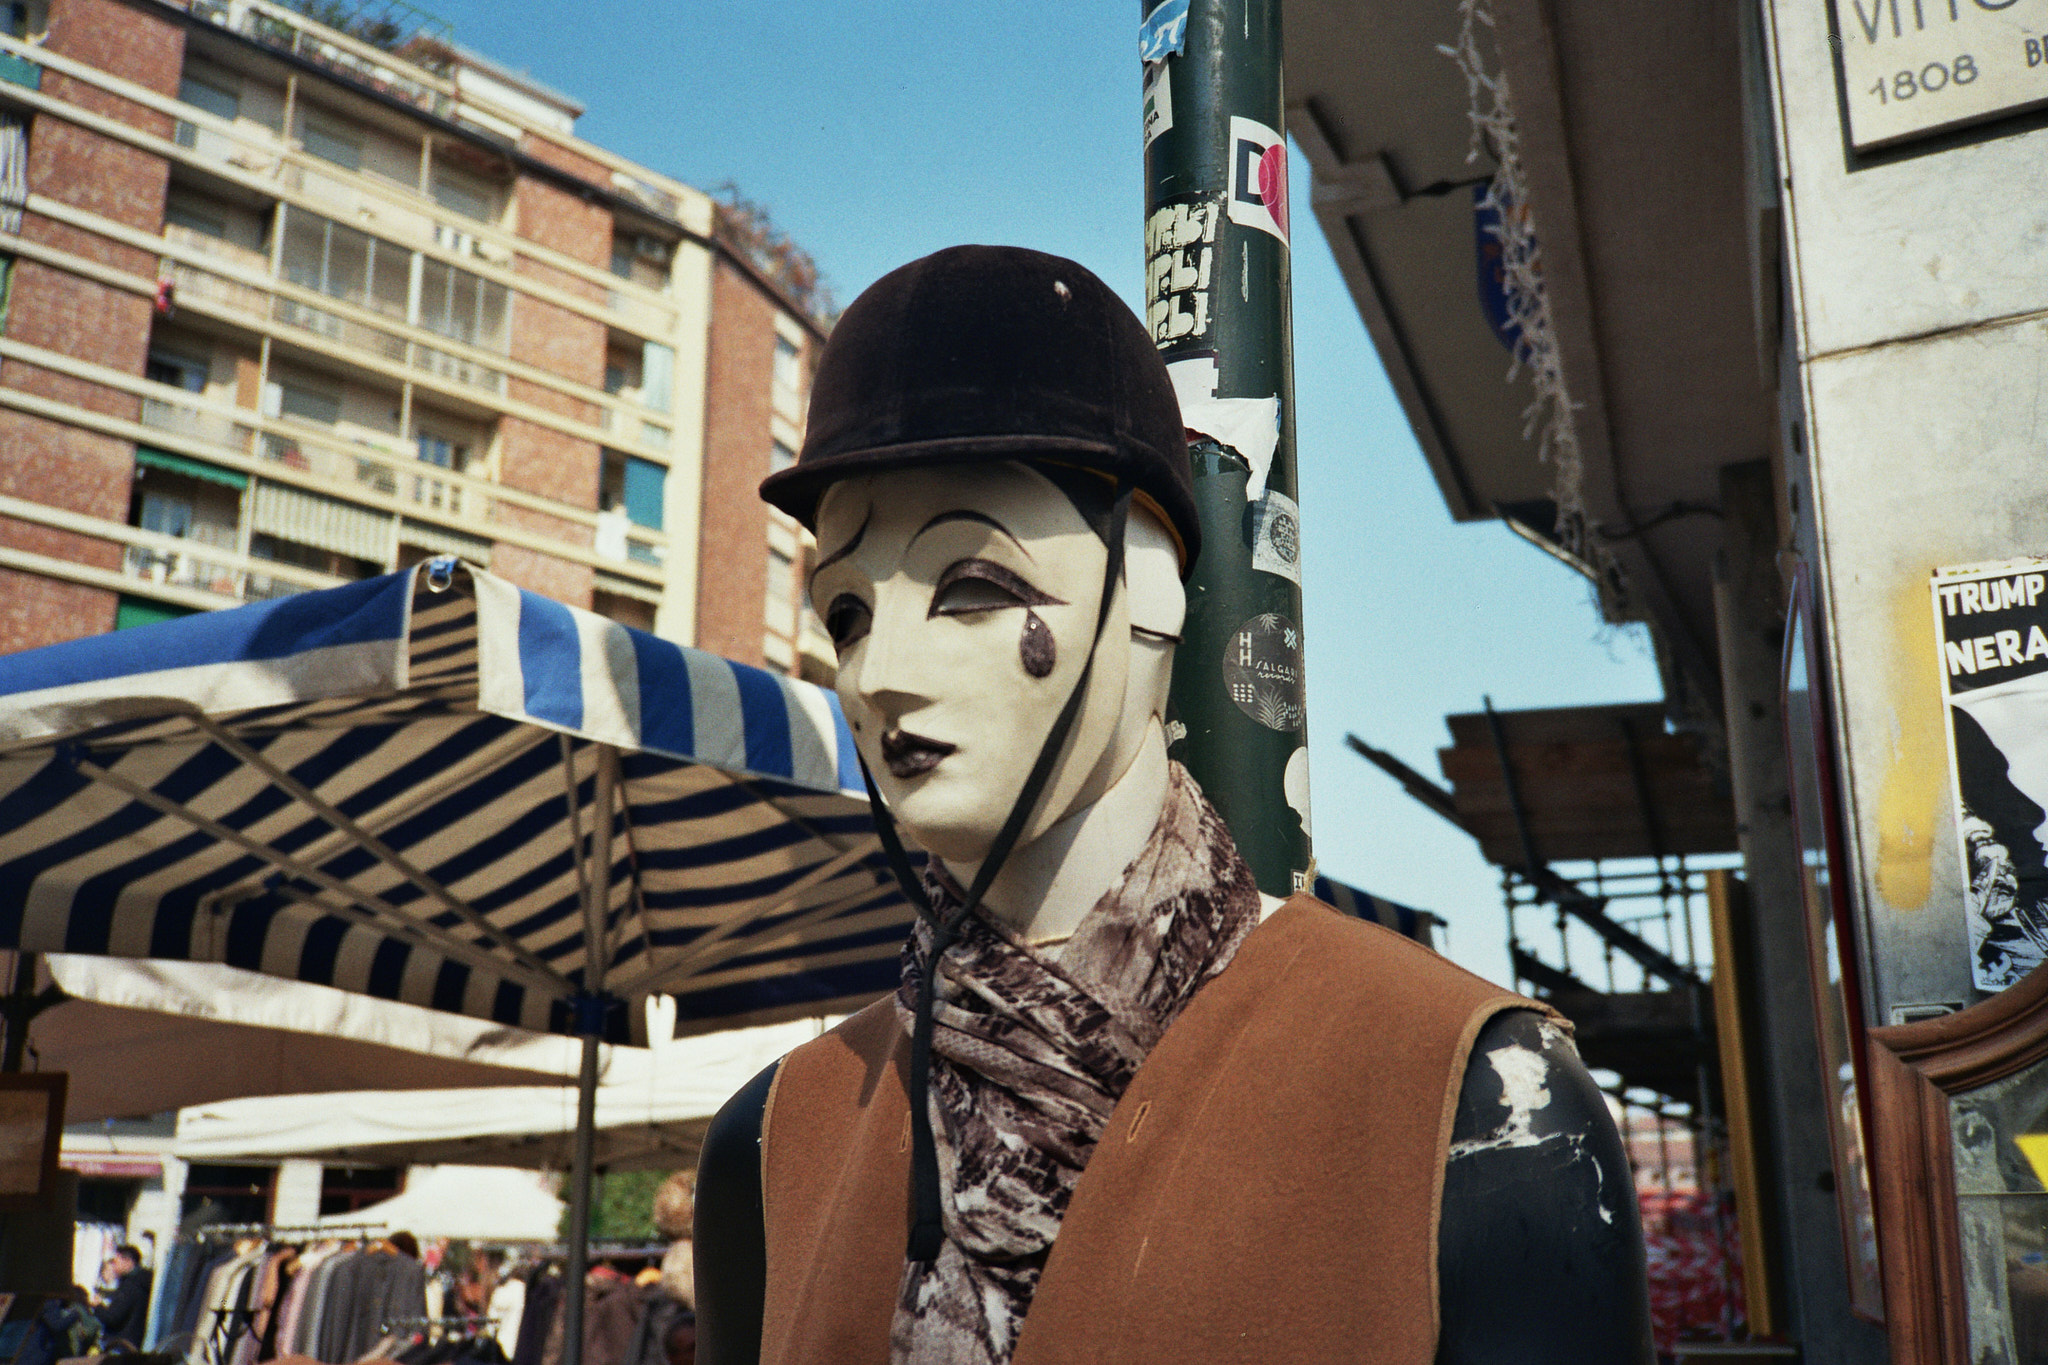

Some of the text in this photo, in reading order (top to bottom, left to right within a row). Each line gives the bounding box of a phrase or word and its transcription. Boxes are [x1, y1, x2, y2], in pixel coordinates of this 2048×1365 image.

[1869, 54, 1979, 104] 1808
[1939, 573, 2045, 616] TRUMP
[1945, 625, 2048, 676] NERA
